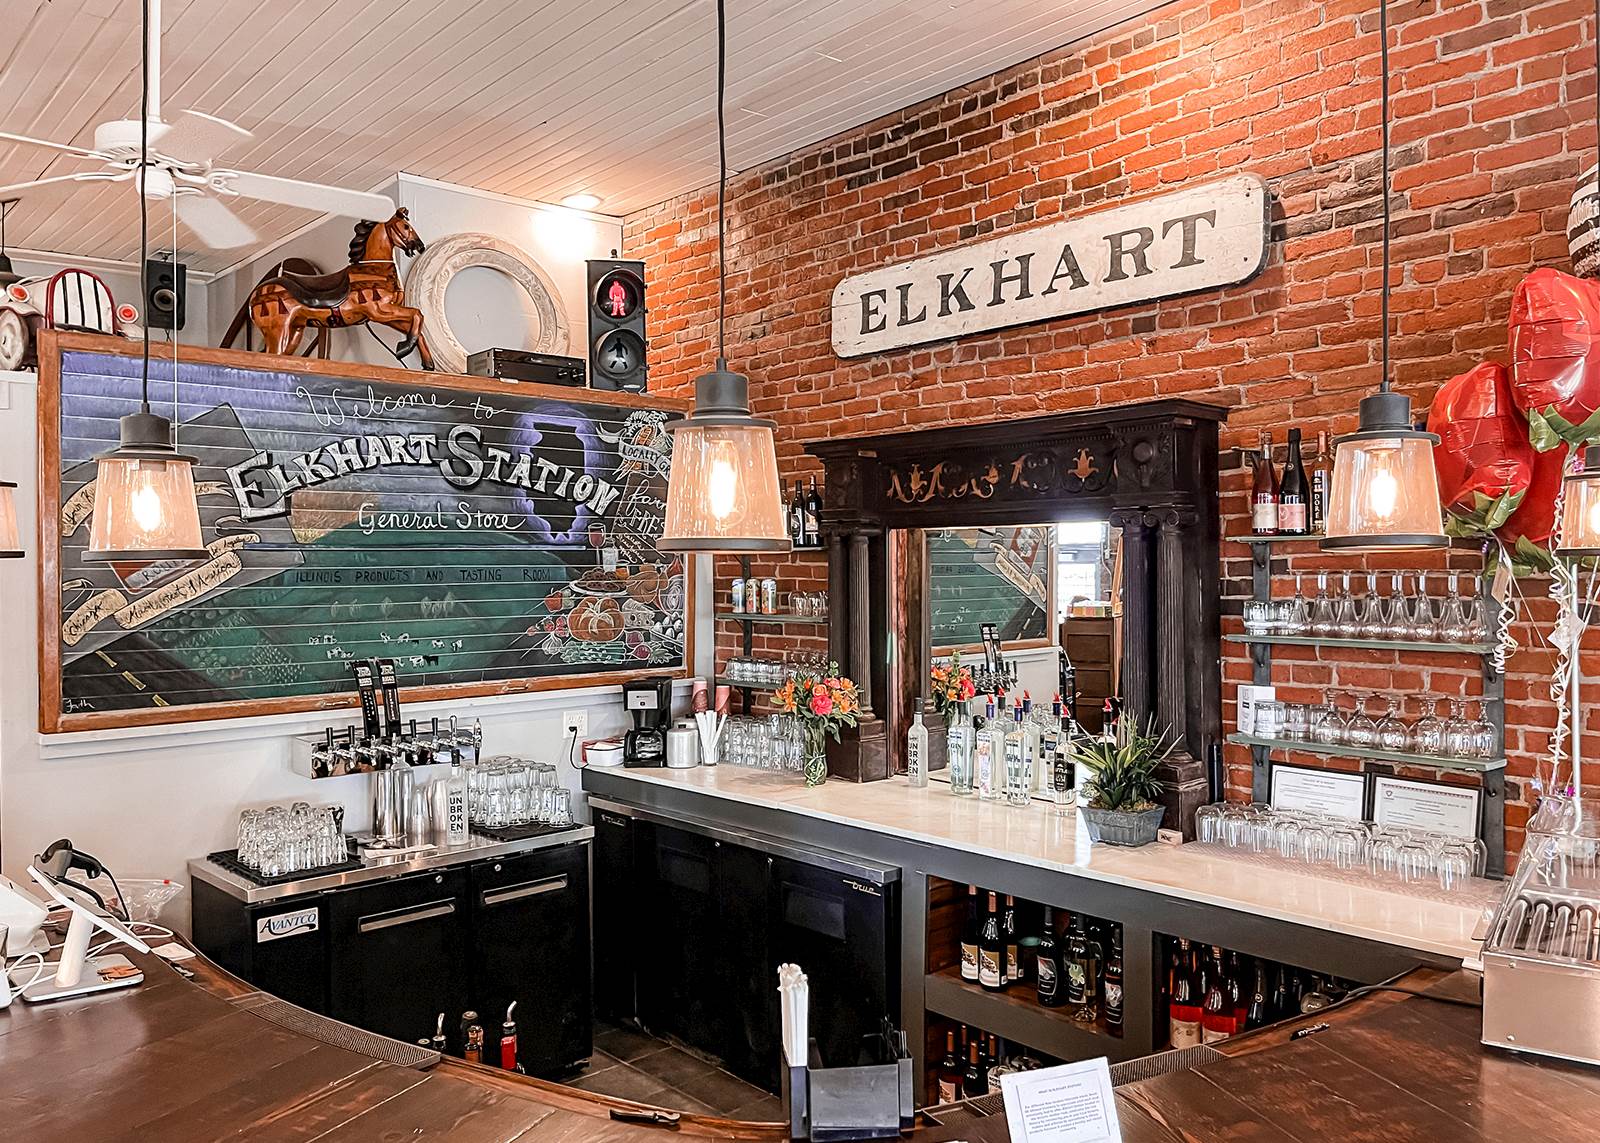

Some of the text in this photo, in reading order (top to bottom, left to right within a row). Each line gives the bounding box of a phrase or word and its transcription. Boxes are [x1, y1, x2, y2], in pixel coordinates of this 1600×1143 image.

[859, 209, 1217, 335] ELKHART
[296, 385, 508, 426] Welcome to
[622, 445, 660, 464] LOCALLY
[226, 424, 620, 520] ELKHART STATION
[358, 502, 527, 535] General Store
[295, 568, 551, 583] ILLINOIS PRODUCTS AND TASTING ROOM
[69, 601, 102, 636] Chicago
[260, 913, 317, 934] AVANTCO
